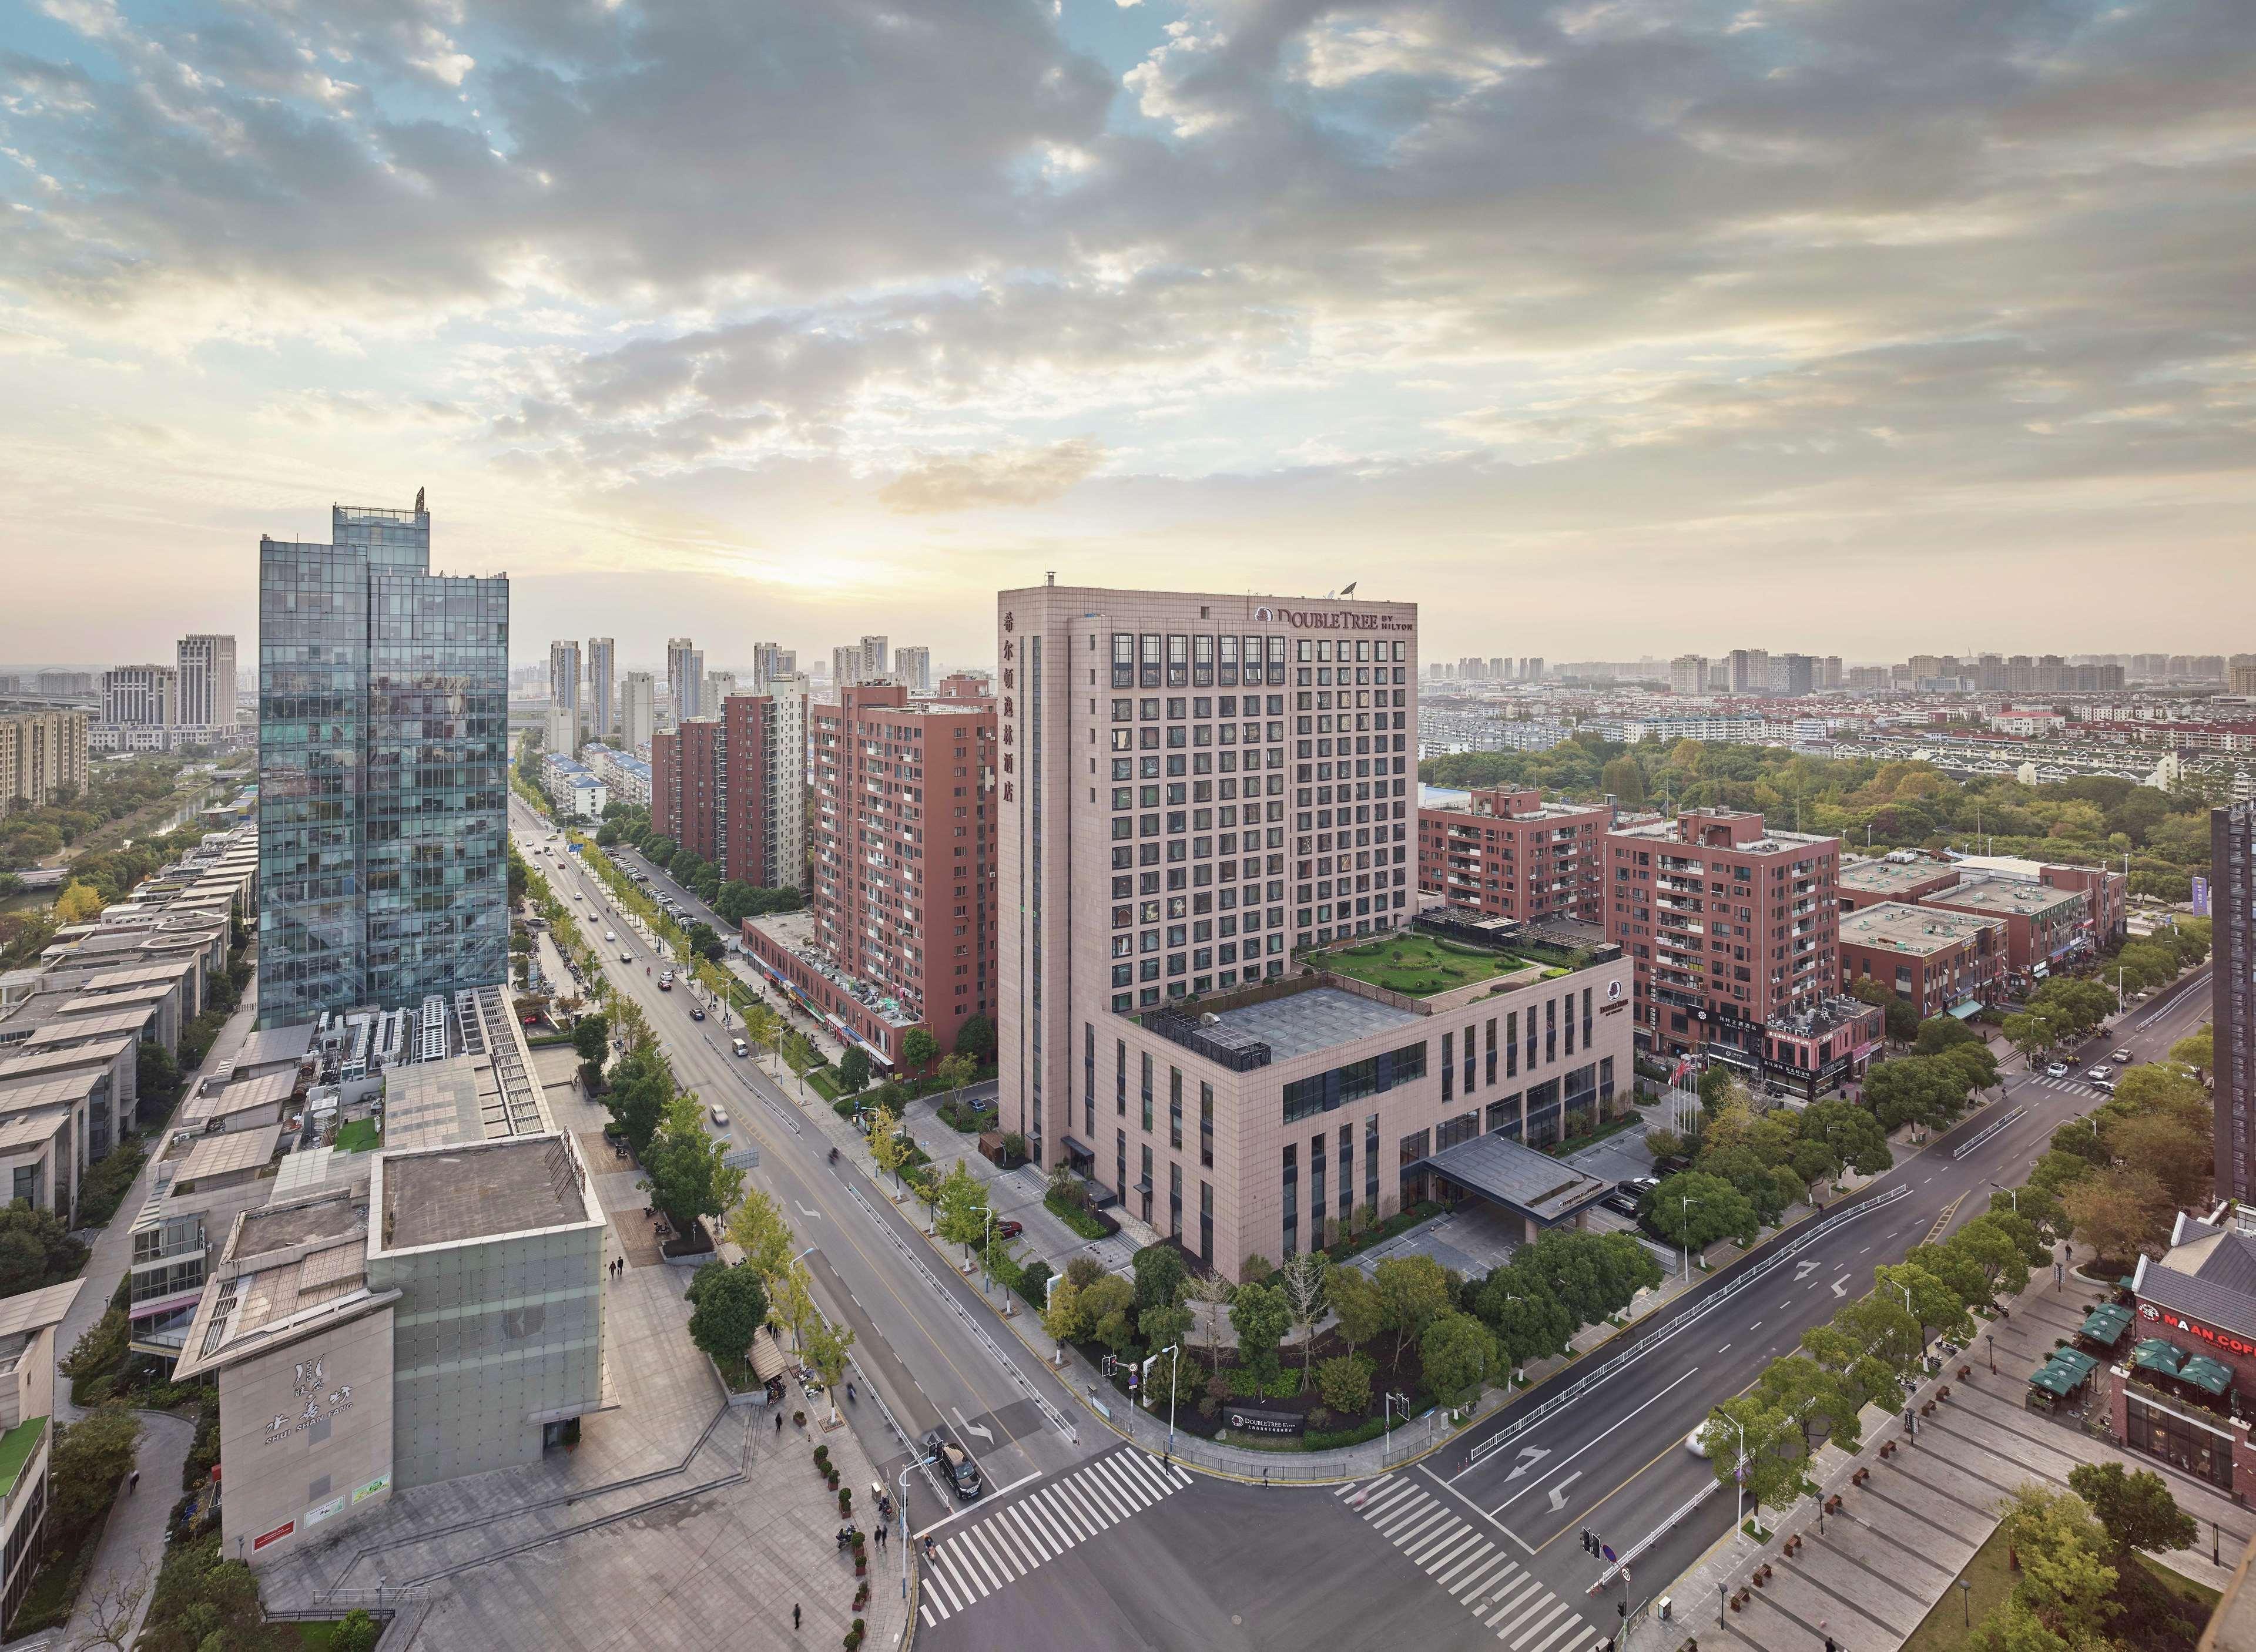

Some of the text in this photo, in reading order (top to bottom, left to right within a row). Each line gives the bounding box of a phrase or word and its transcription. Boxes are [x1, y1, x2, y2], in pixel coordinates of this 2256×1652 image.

[1003, 611, 1014, 803] 希尔顿逸林酒店
[2164, 1314, 2256, 1358] MAAN COF
[265, 1402, 353, 1445] SHUI SHAN FANG
[1623, 1570, 1630, 1579] 40
